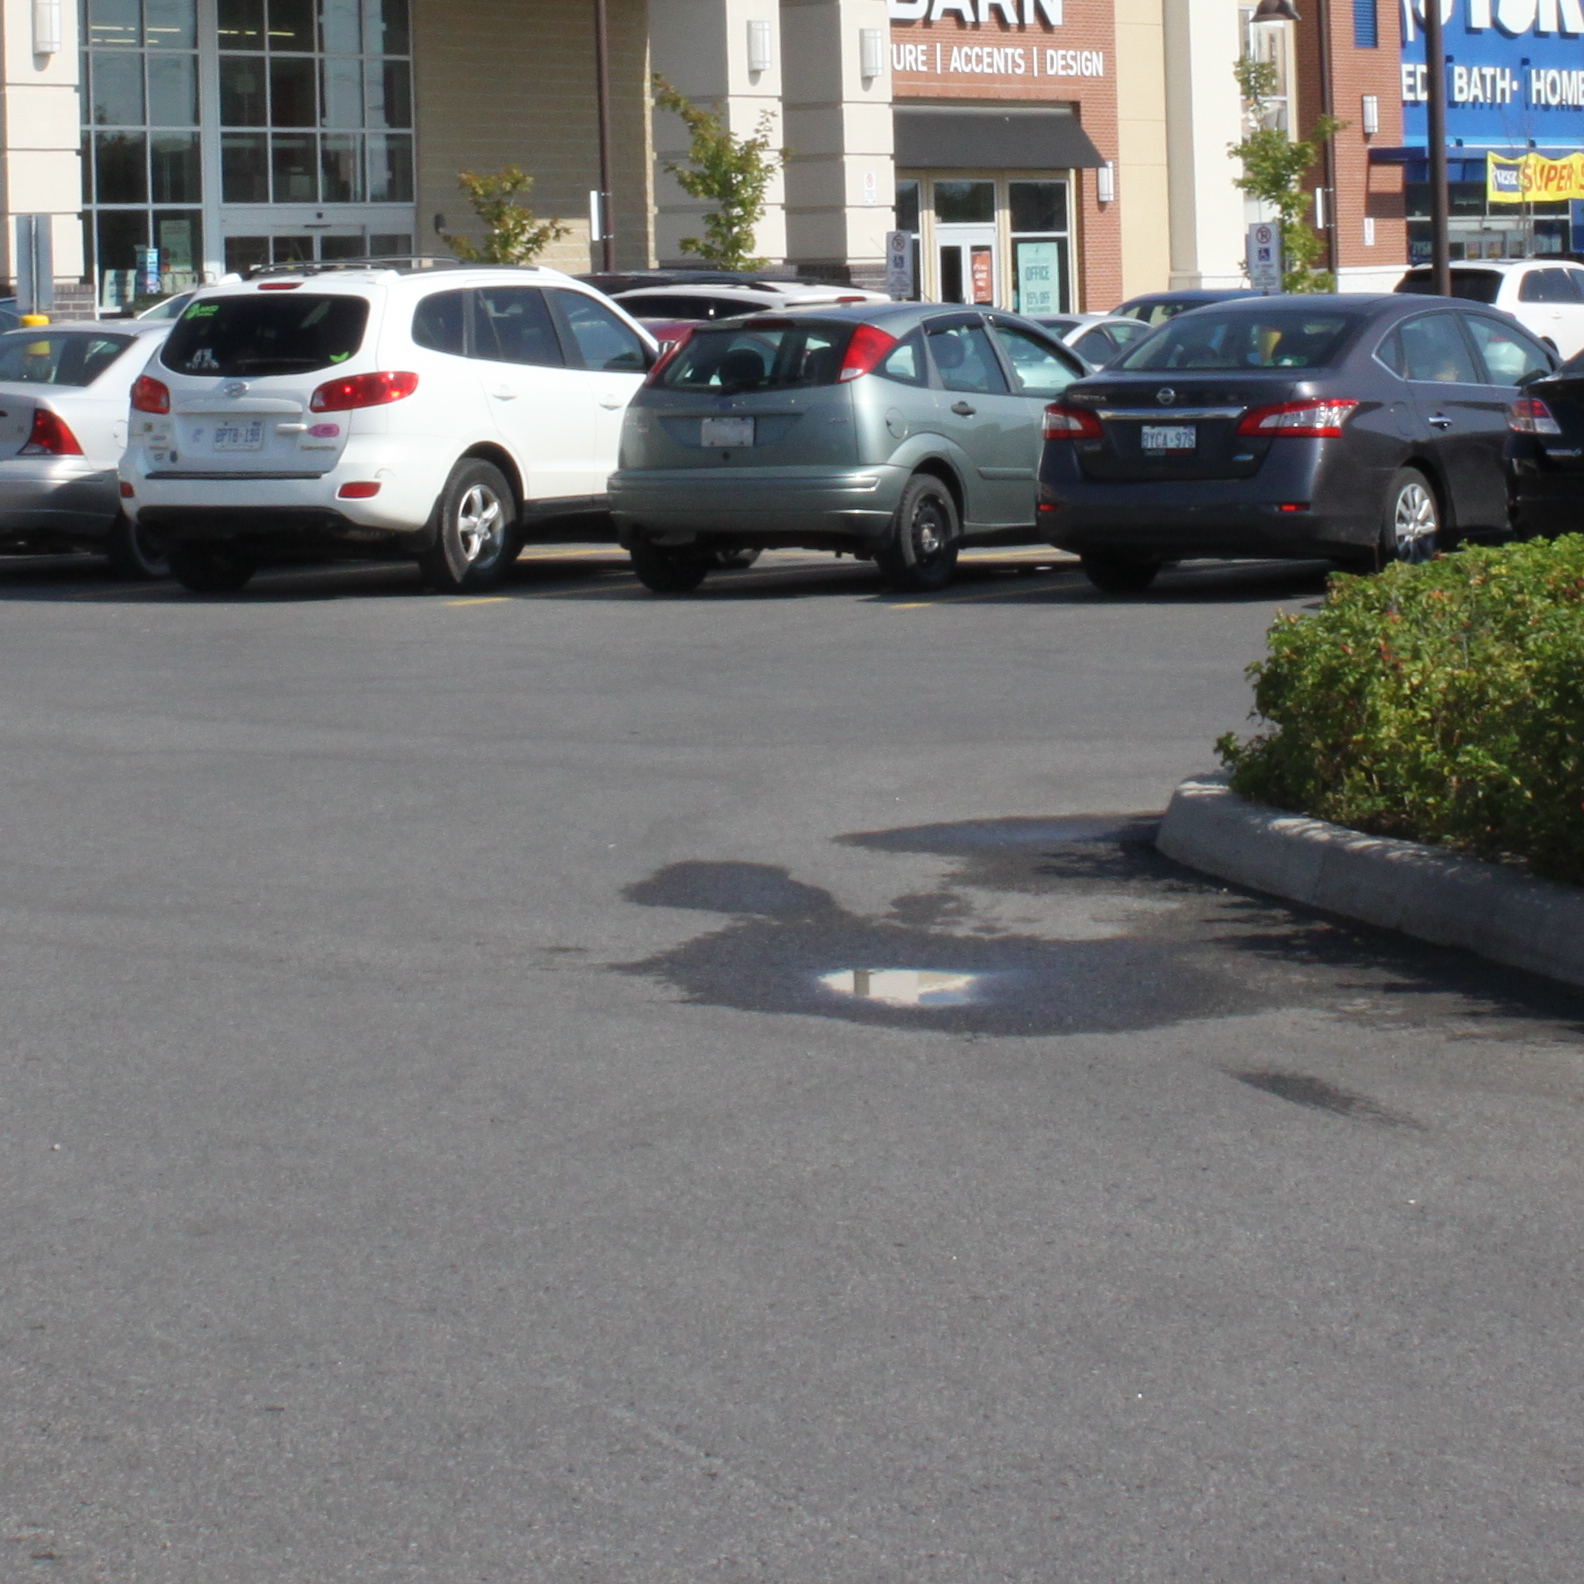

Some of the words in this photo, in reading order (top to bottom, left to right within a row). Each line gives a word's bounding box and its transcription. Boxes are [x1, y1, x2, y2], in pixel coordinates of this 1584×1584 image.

[949, 46, 1025, 75] ACCENTS
[1046, 48, 1104, 77] DESIGN
[1453, 65, 1510, 104] BATH
[1522, 163, 1574, 192] SUPER
